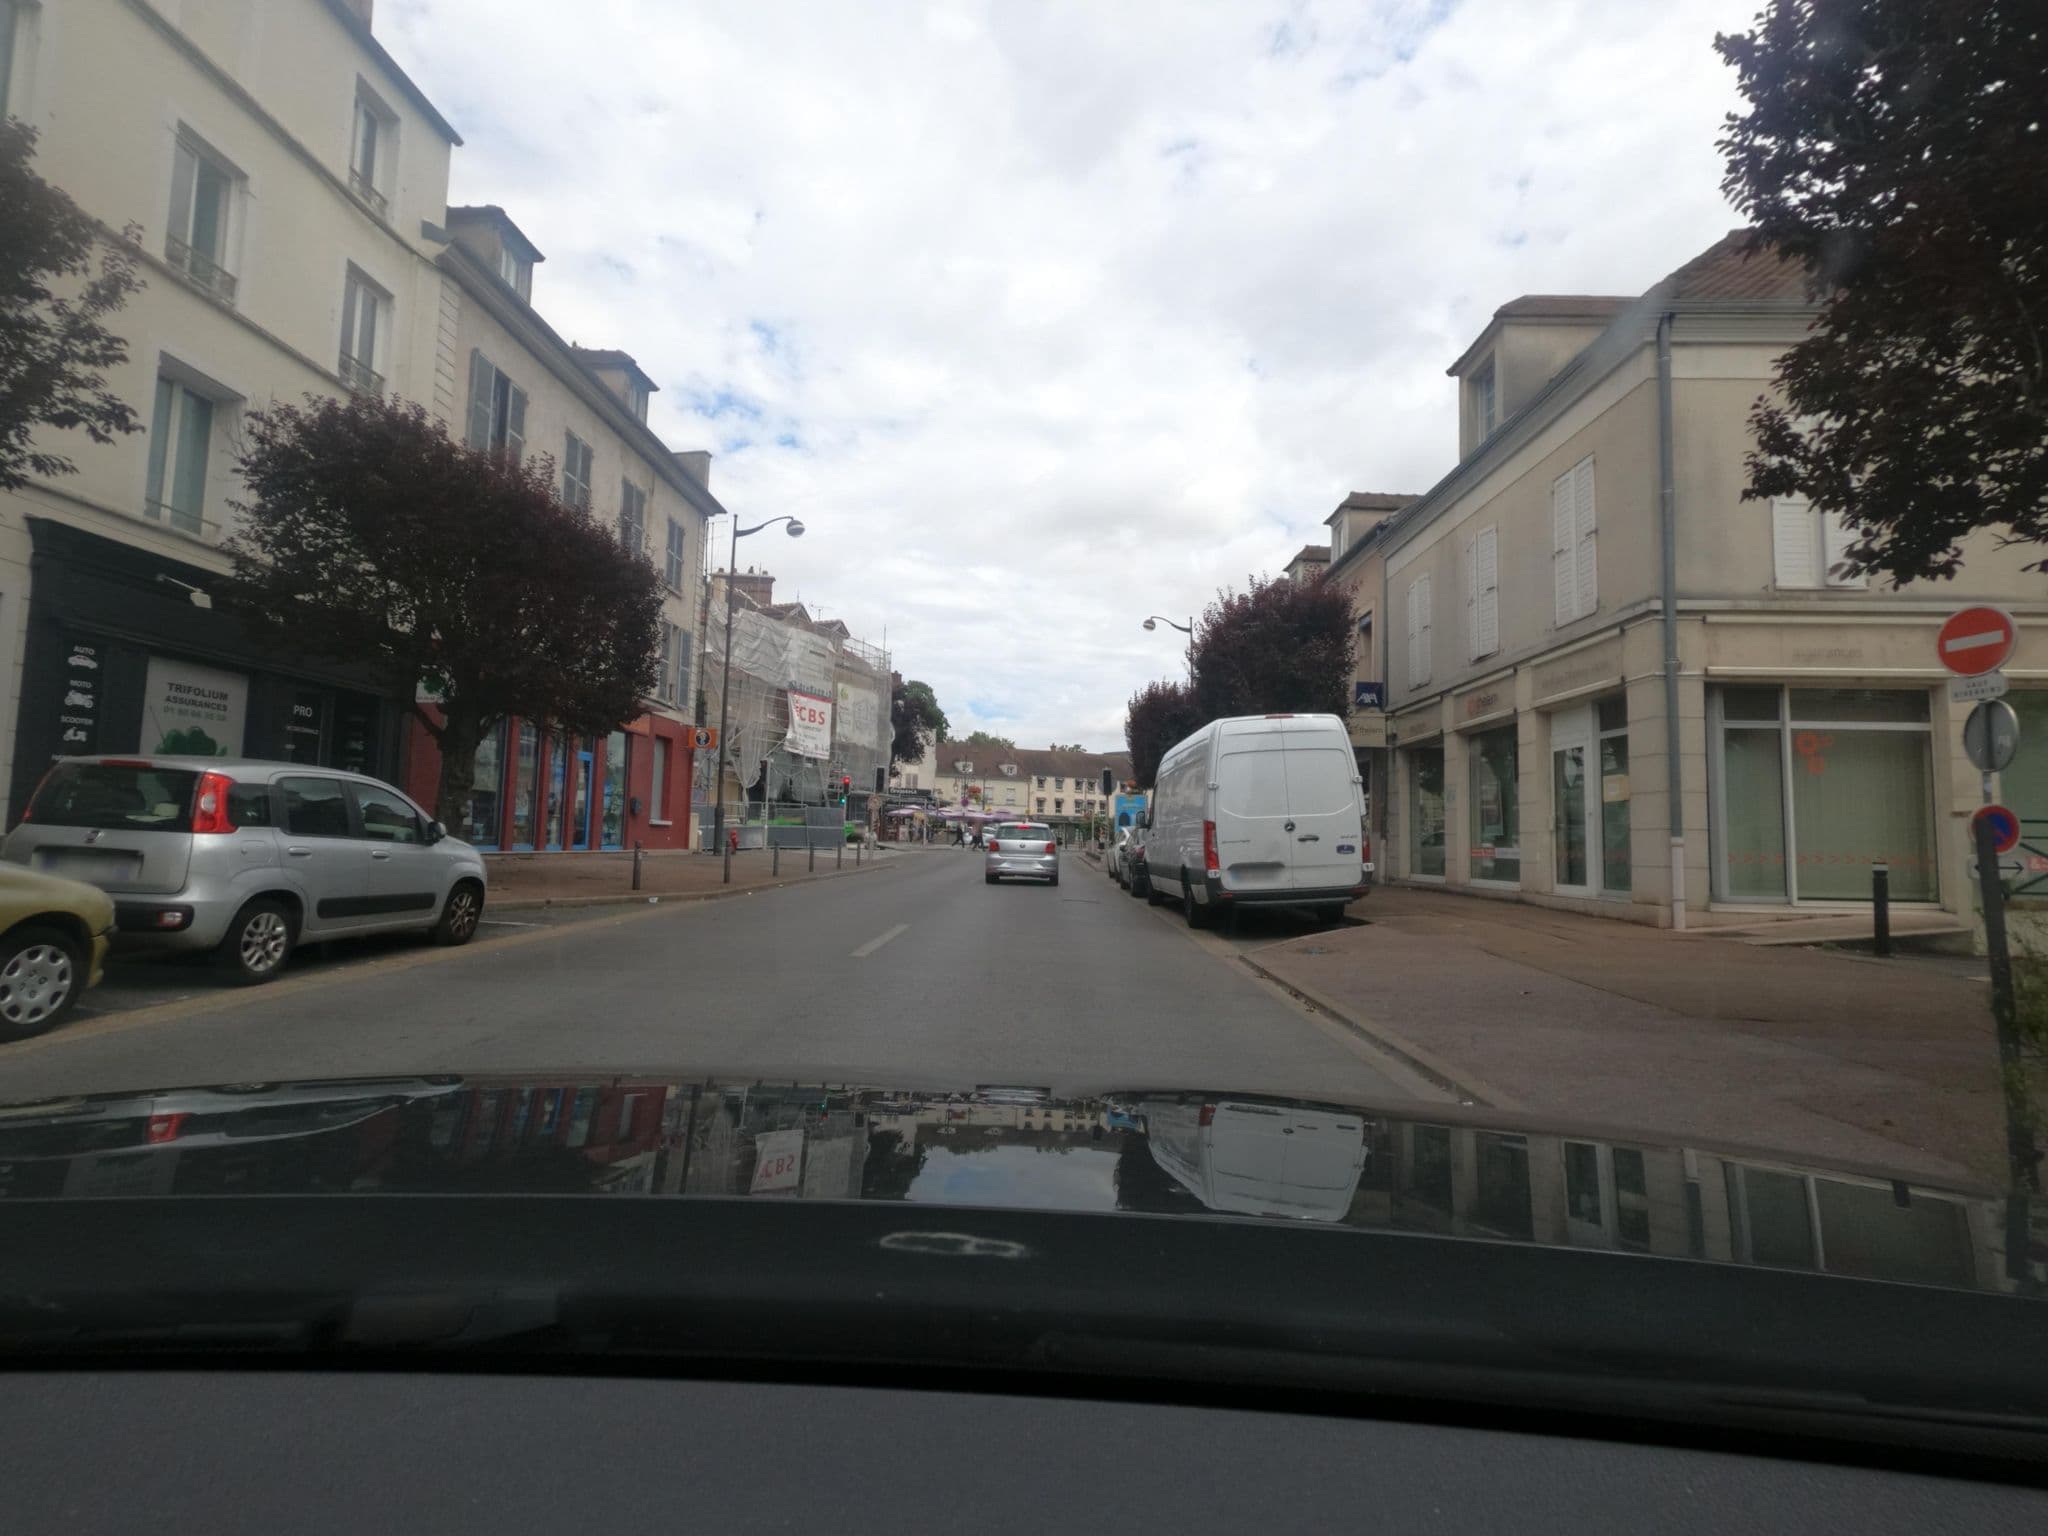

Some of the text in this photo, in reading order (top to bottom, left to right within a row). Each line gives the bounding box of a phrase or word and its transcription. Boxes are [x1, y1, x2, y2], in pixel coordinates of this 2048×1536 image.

[73, 645, 95, 656] AUTO
[69, 679, 93, 689] MOTO
[167, 682, 229, 701] TRIFOLIUM
[1357, 692, 1378, 704] AXA
[165, 695, 228, 712] ASSURANCES
[293, 704, 313, 718] PRO
[799, 705, 826, 726] CBS
